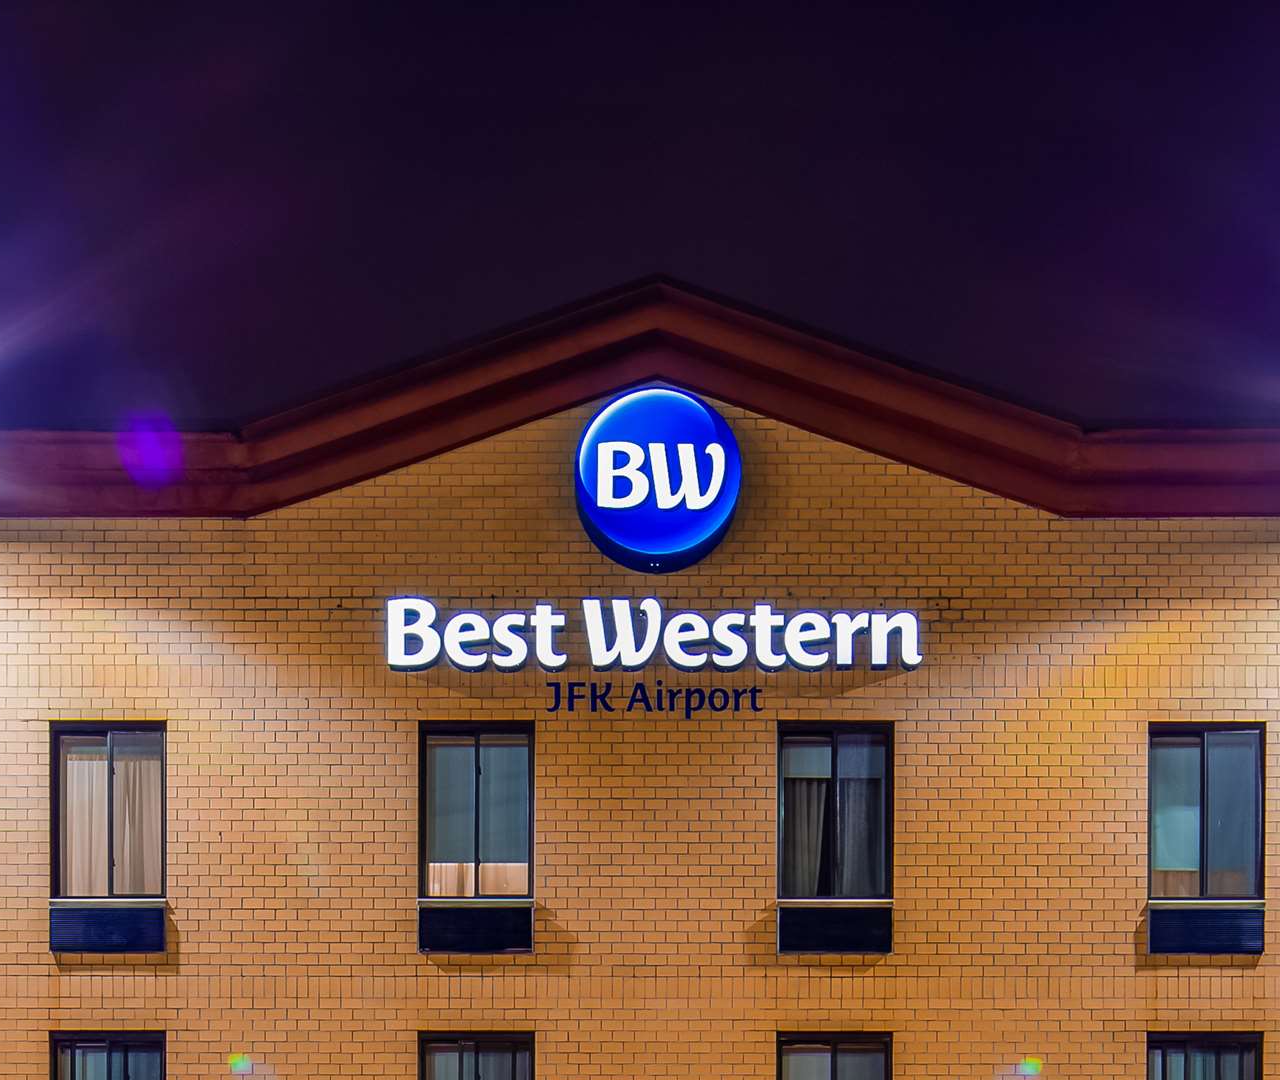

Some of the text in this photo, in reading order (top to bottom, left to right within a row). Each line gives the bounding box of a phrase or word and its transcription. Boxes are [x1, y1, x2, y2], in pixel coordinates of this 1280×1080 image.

[597, 440, 725, 511] BW
[386, 597, 923, 671] Best Western
[546, 679, 764, 719] JFK Airport
